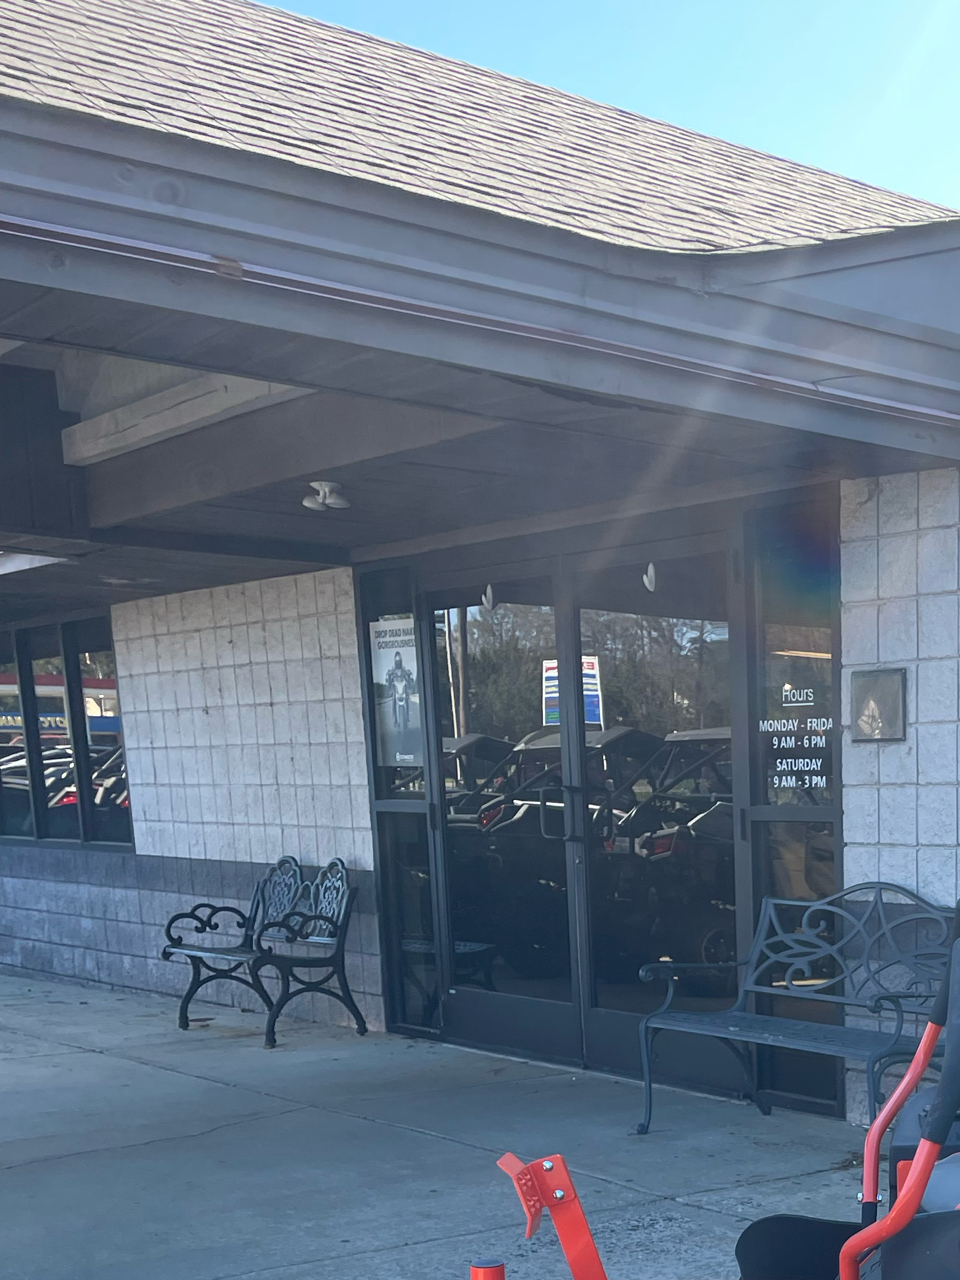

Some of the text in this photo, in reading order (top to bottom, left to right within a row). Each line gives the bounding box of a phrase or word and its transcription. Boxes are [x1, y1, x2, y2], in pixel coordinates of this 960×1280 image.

[375, 630, 388, 639] DROP
[388, 629, 401, 638] DEAD
[782, 687, 814, 702] Hours
[759, 719, 799, 732] MONDAY
[772, 736, 779, 749] 9
[780, 736, 796, 749] AM
[803, 735, 810, 748] 6
[811, 735, 826, 748] PM
[776, 758, 823, 771] SATURDAY
[773, 776, 779, 788] 9
[780, 776, 796, 788] AM
[804, 776, 810, 788] 3
[811, 775, 827, 788] PM
